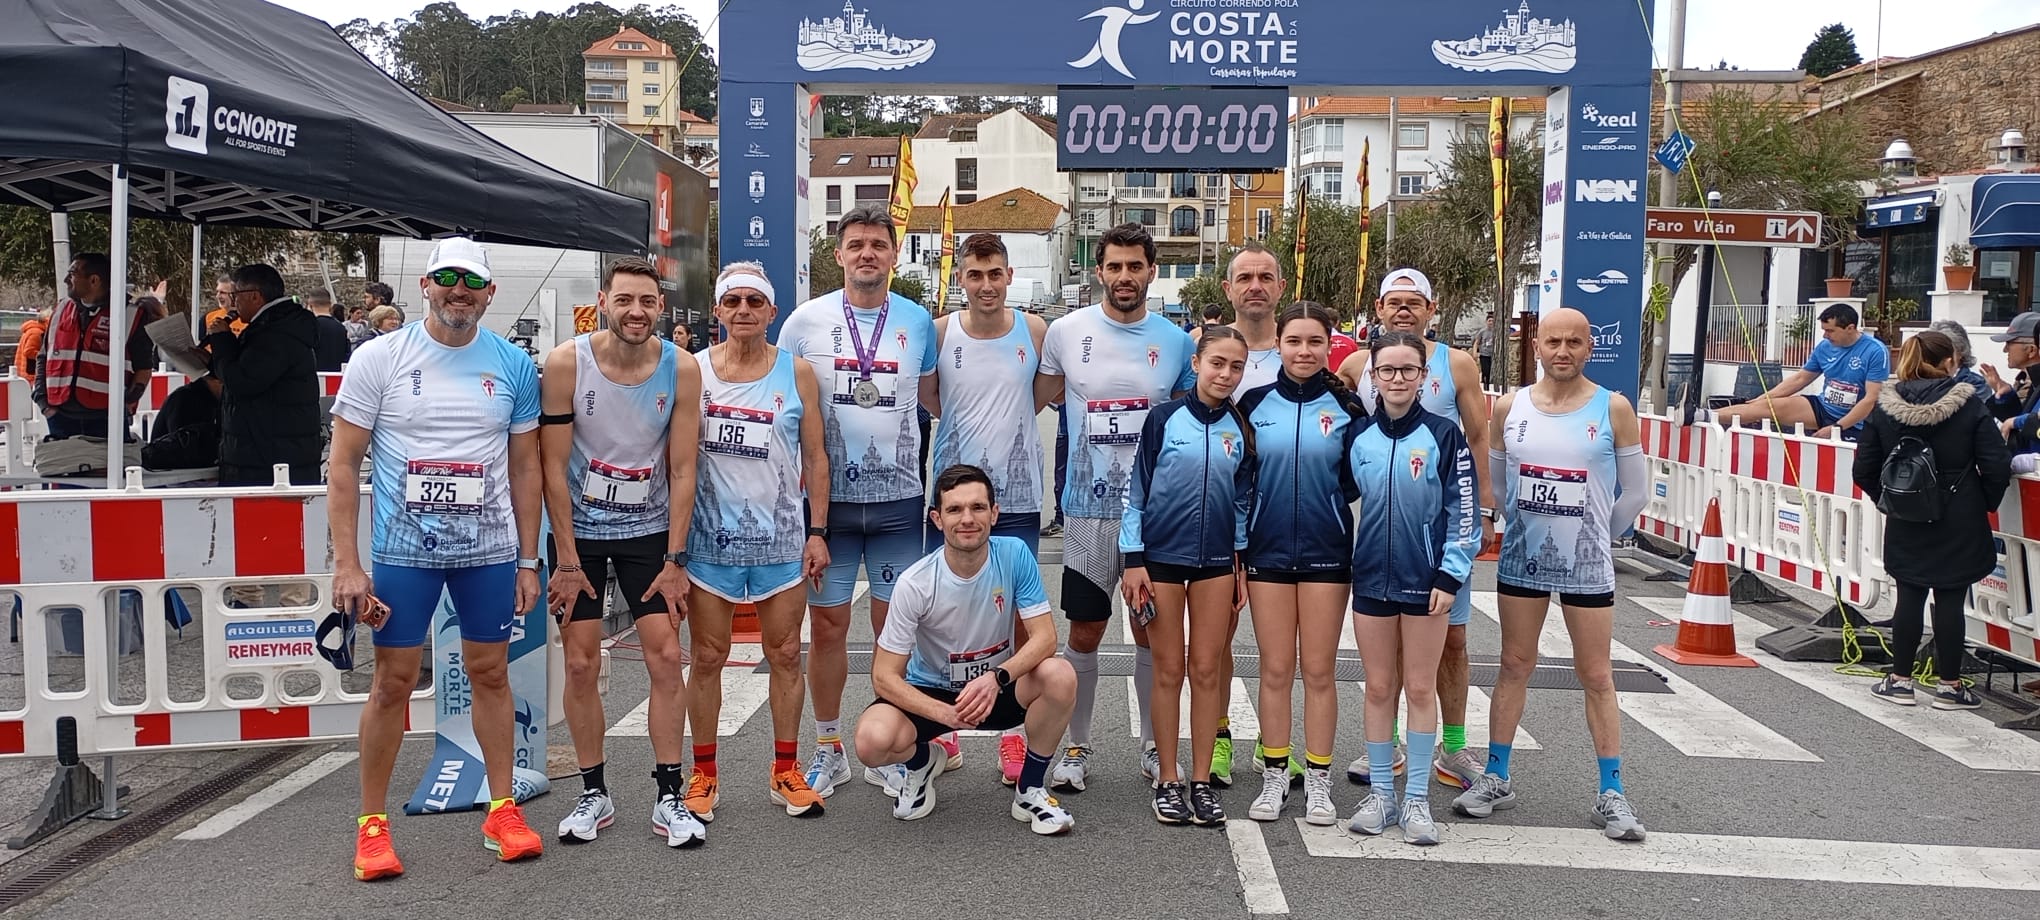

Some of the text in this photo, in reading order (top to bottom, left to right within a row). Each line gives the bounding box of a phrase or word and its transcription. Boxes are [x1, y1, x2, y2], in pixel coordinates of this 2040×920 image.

[1170, 0, 1299, 8] CIRCUITO CORRENDO POLA
[1170, 12, 1285, 36] COSTA
[1289, 20, 1297, 36] DA
[1169, 40, 1298, 64] MORTE
[1210, 66, 1251, 77] Carreiras
[214, 106, 297, 147] CCNORTE
[1065, 104, 1278, 154] 00:00:00
[1597, 111, 1638, 127] xeal
[224, 137, 286, 157] ALL FOR SPORTS EVENTS
[1648, 218, 1735, 235] Faro Vilán
[831, 326, 842, 354] evelb
[1081, 336, 1093, 364] evelb
[954, 346, 963, 369] evelb
[410, 369, 422, 396] evelb
[585, 390, 596, 416] evelb
[718, 423, 745, 445] 136
[1109, 417, 1118, 434] 5
[1517, 420, 1528, 443] evelb
[420, 481, 456, 503] 325
[606, 484, 618, 501] 11
[1532, 483, 1558, 504] 134
[227, 624, 315, 637] ALQUILERES
[228, 641, 315, 660] RENEYMAR
[965, 662, 989, 680] 138
[448, 652, 461, 716] MORTE
[422, 760, 465, 813] MET
